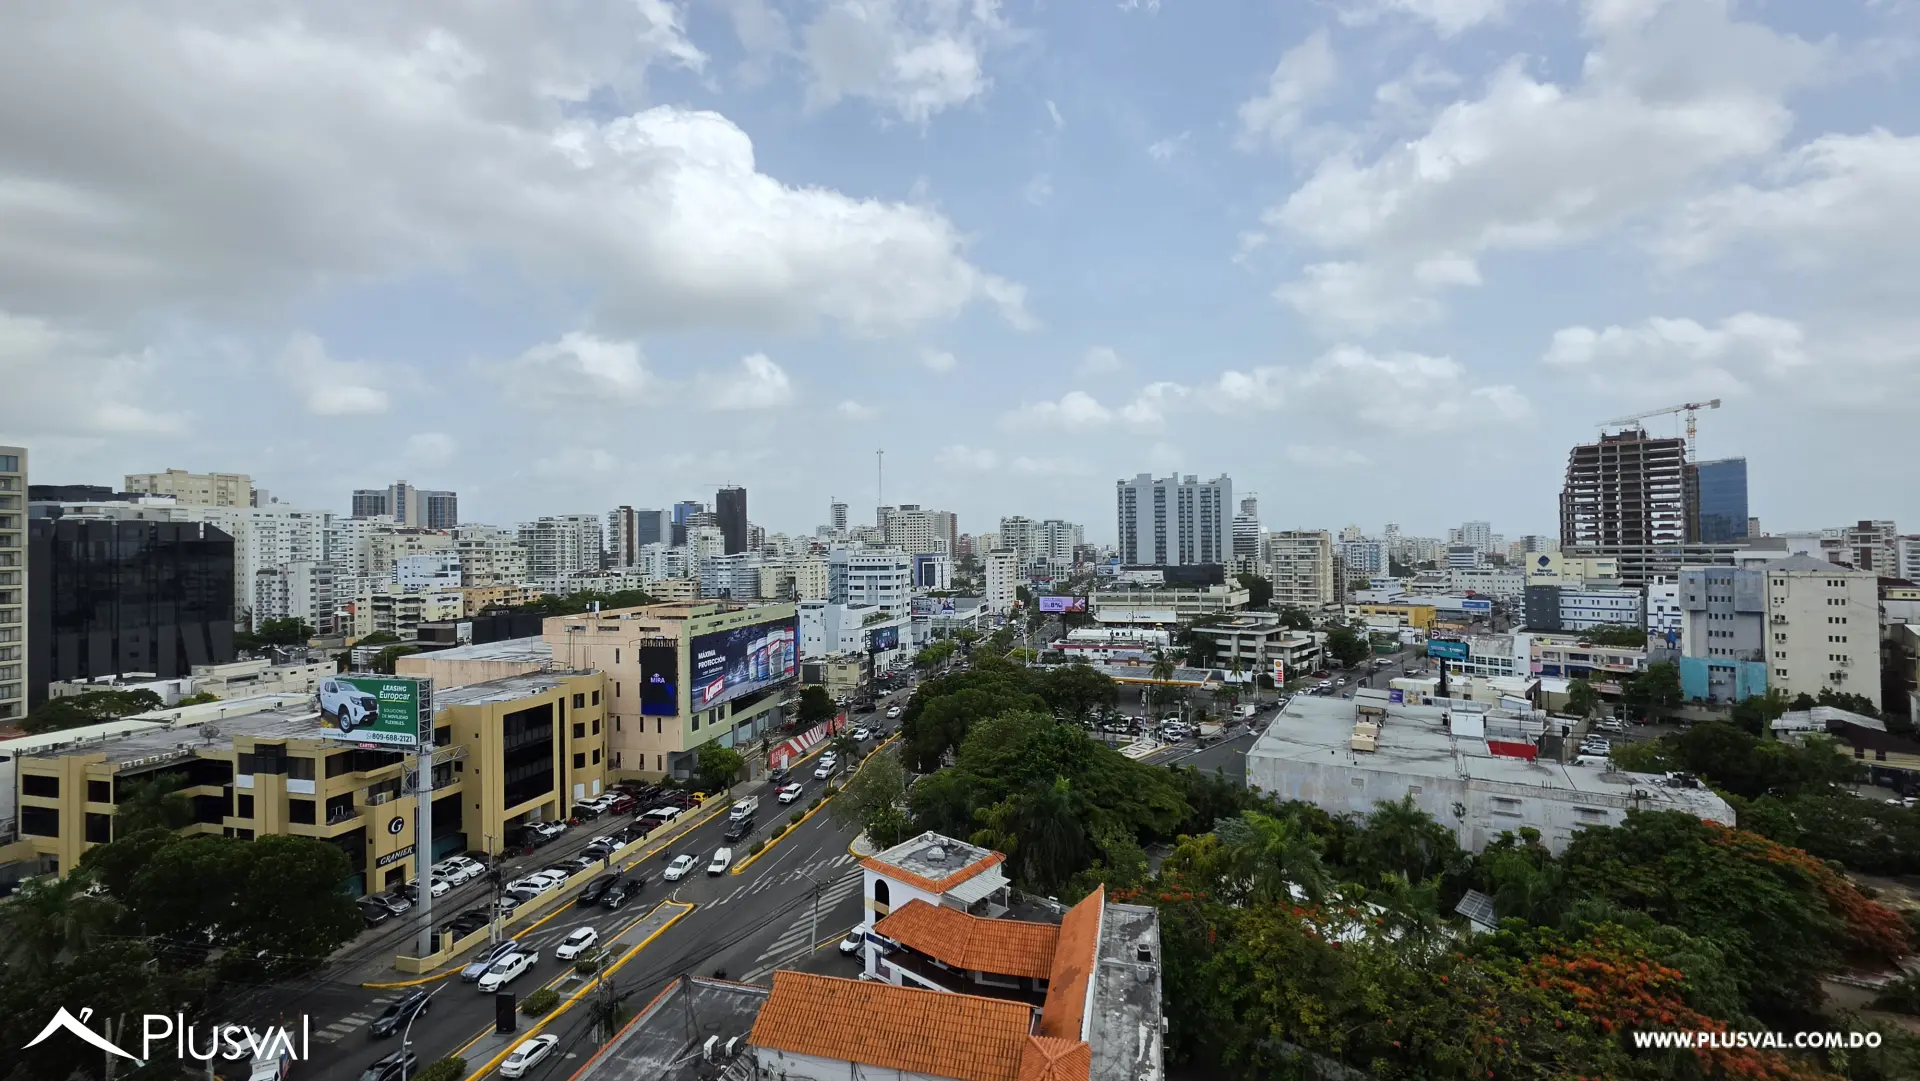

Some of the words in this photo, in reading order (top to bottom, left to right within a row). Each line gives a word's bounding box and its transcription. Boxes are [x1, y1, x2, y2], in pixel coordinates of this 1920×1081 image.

[698, 649, 716, 660] MÁXIMA
[698, 655, 726, 669] PROTECCIÓN
[382, 684, 407, 692] LEASING
[379, 691, 411, 701] Europcar
[371, 732, 412, 743] 809-688-2121
[391, 818, 403, 833] G
[380, 846, 413, 865] GRANIER
